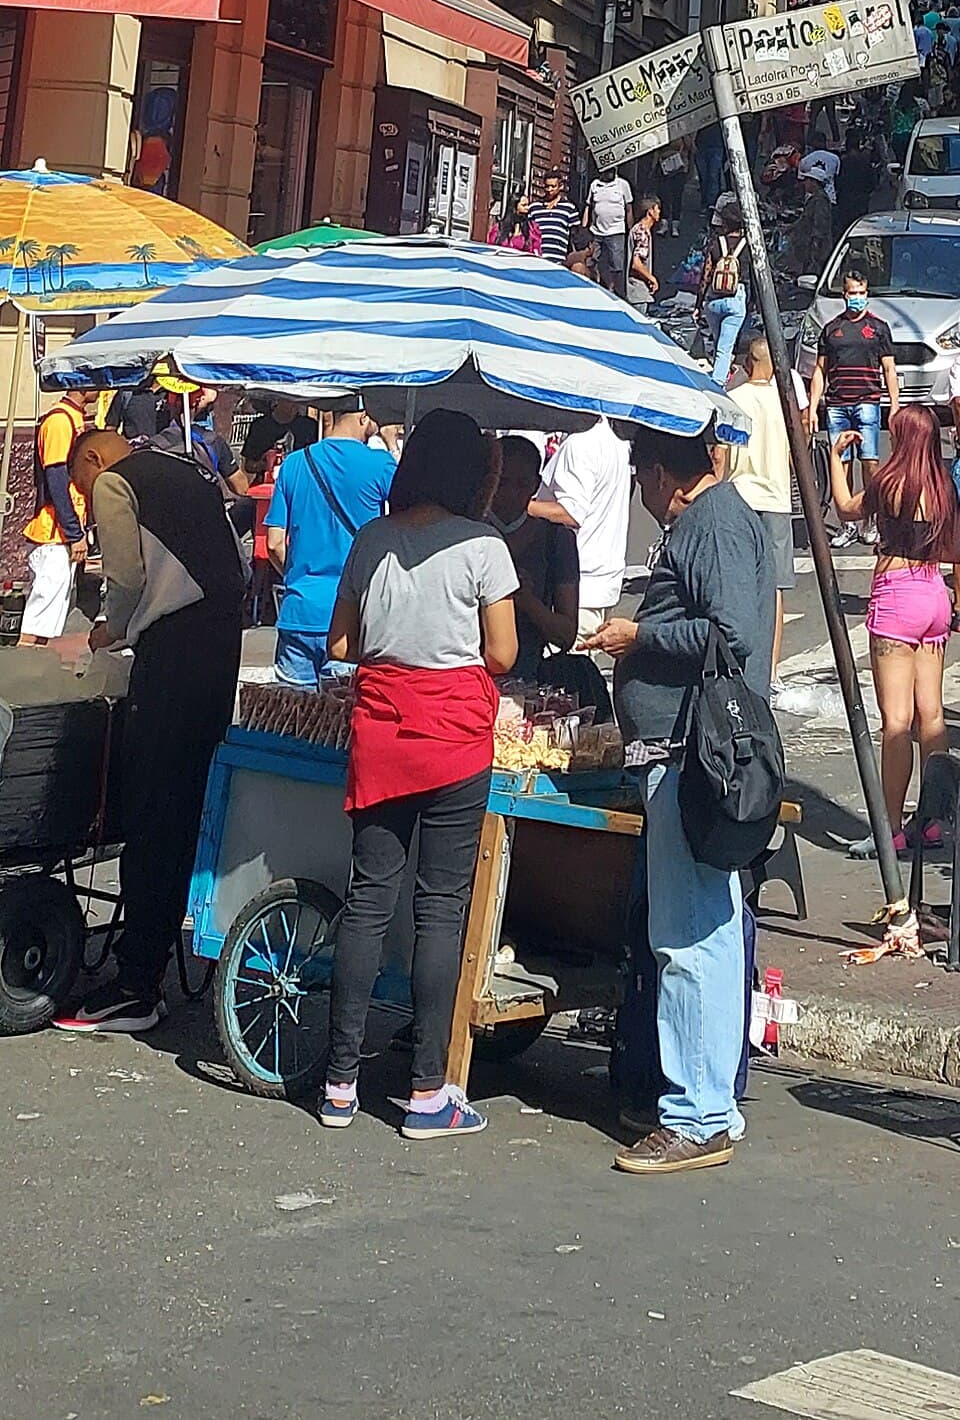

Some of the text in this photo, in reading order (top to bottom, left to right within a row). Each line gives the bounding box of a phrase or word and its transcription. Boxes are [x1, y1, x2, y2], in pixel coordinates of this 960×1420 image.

[747, 69, 789, 86] Ladeira
[573, 86, 602, 124] 25
[606, 74, 634, 110] de
[754, 87, 801, 106] 133 a 95
[590, 131, 610, 148] Rua
[609, 122, 634, 140] Vinte
[643, 107, 672, 125] Cinco
